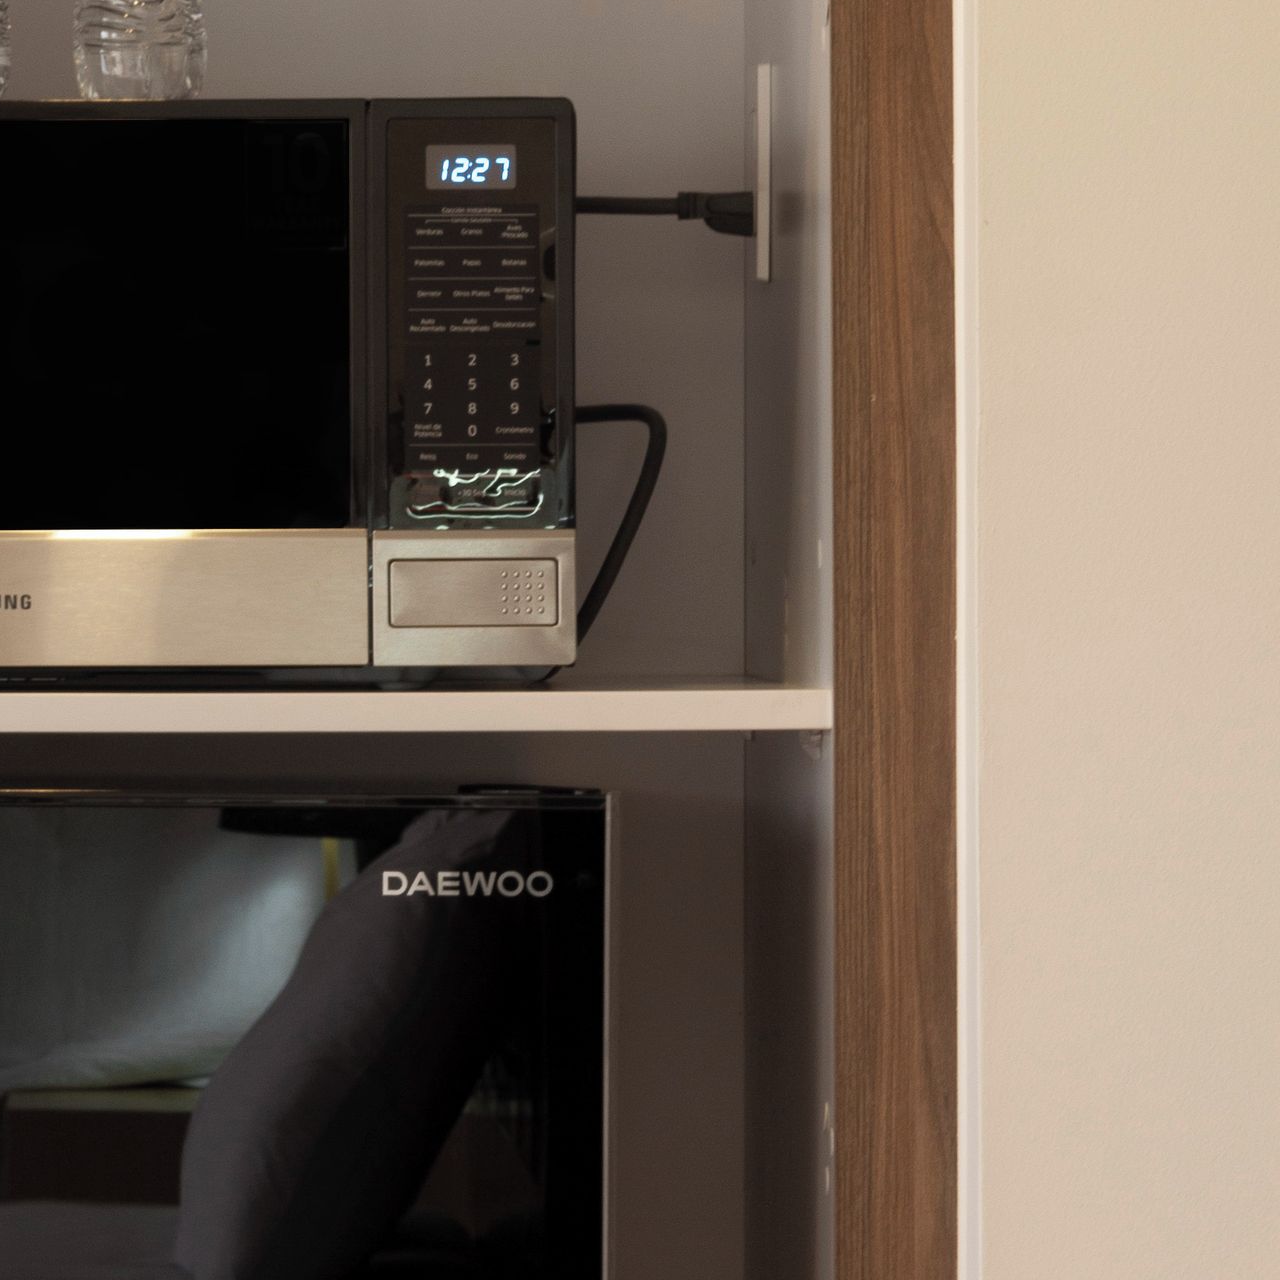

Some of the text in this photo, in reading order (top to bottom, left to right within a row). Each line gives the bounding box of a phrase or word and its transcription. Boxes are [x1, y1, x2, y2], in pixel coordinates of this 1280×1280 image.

[441, 157, 510, 183] 12:27
[424, 353, 432, 367] 1
[468, 353, 477, 367] 2
[510, 353, 520, 367] 3
[424, 378, 432, 391] 4
[468, 378, 477, 391] 5
[510, 378, 520, 391] 6
[424, 402, 432, 415] 7
[468, 402, 477, 415] 8
[510, 402, 520, 415] 9
[468, 424, 477, 437] 0
[382, 870, 554, 897] DAEWOO
